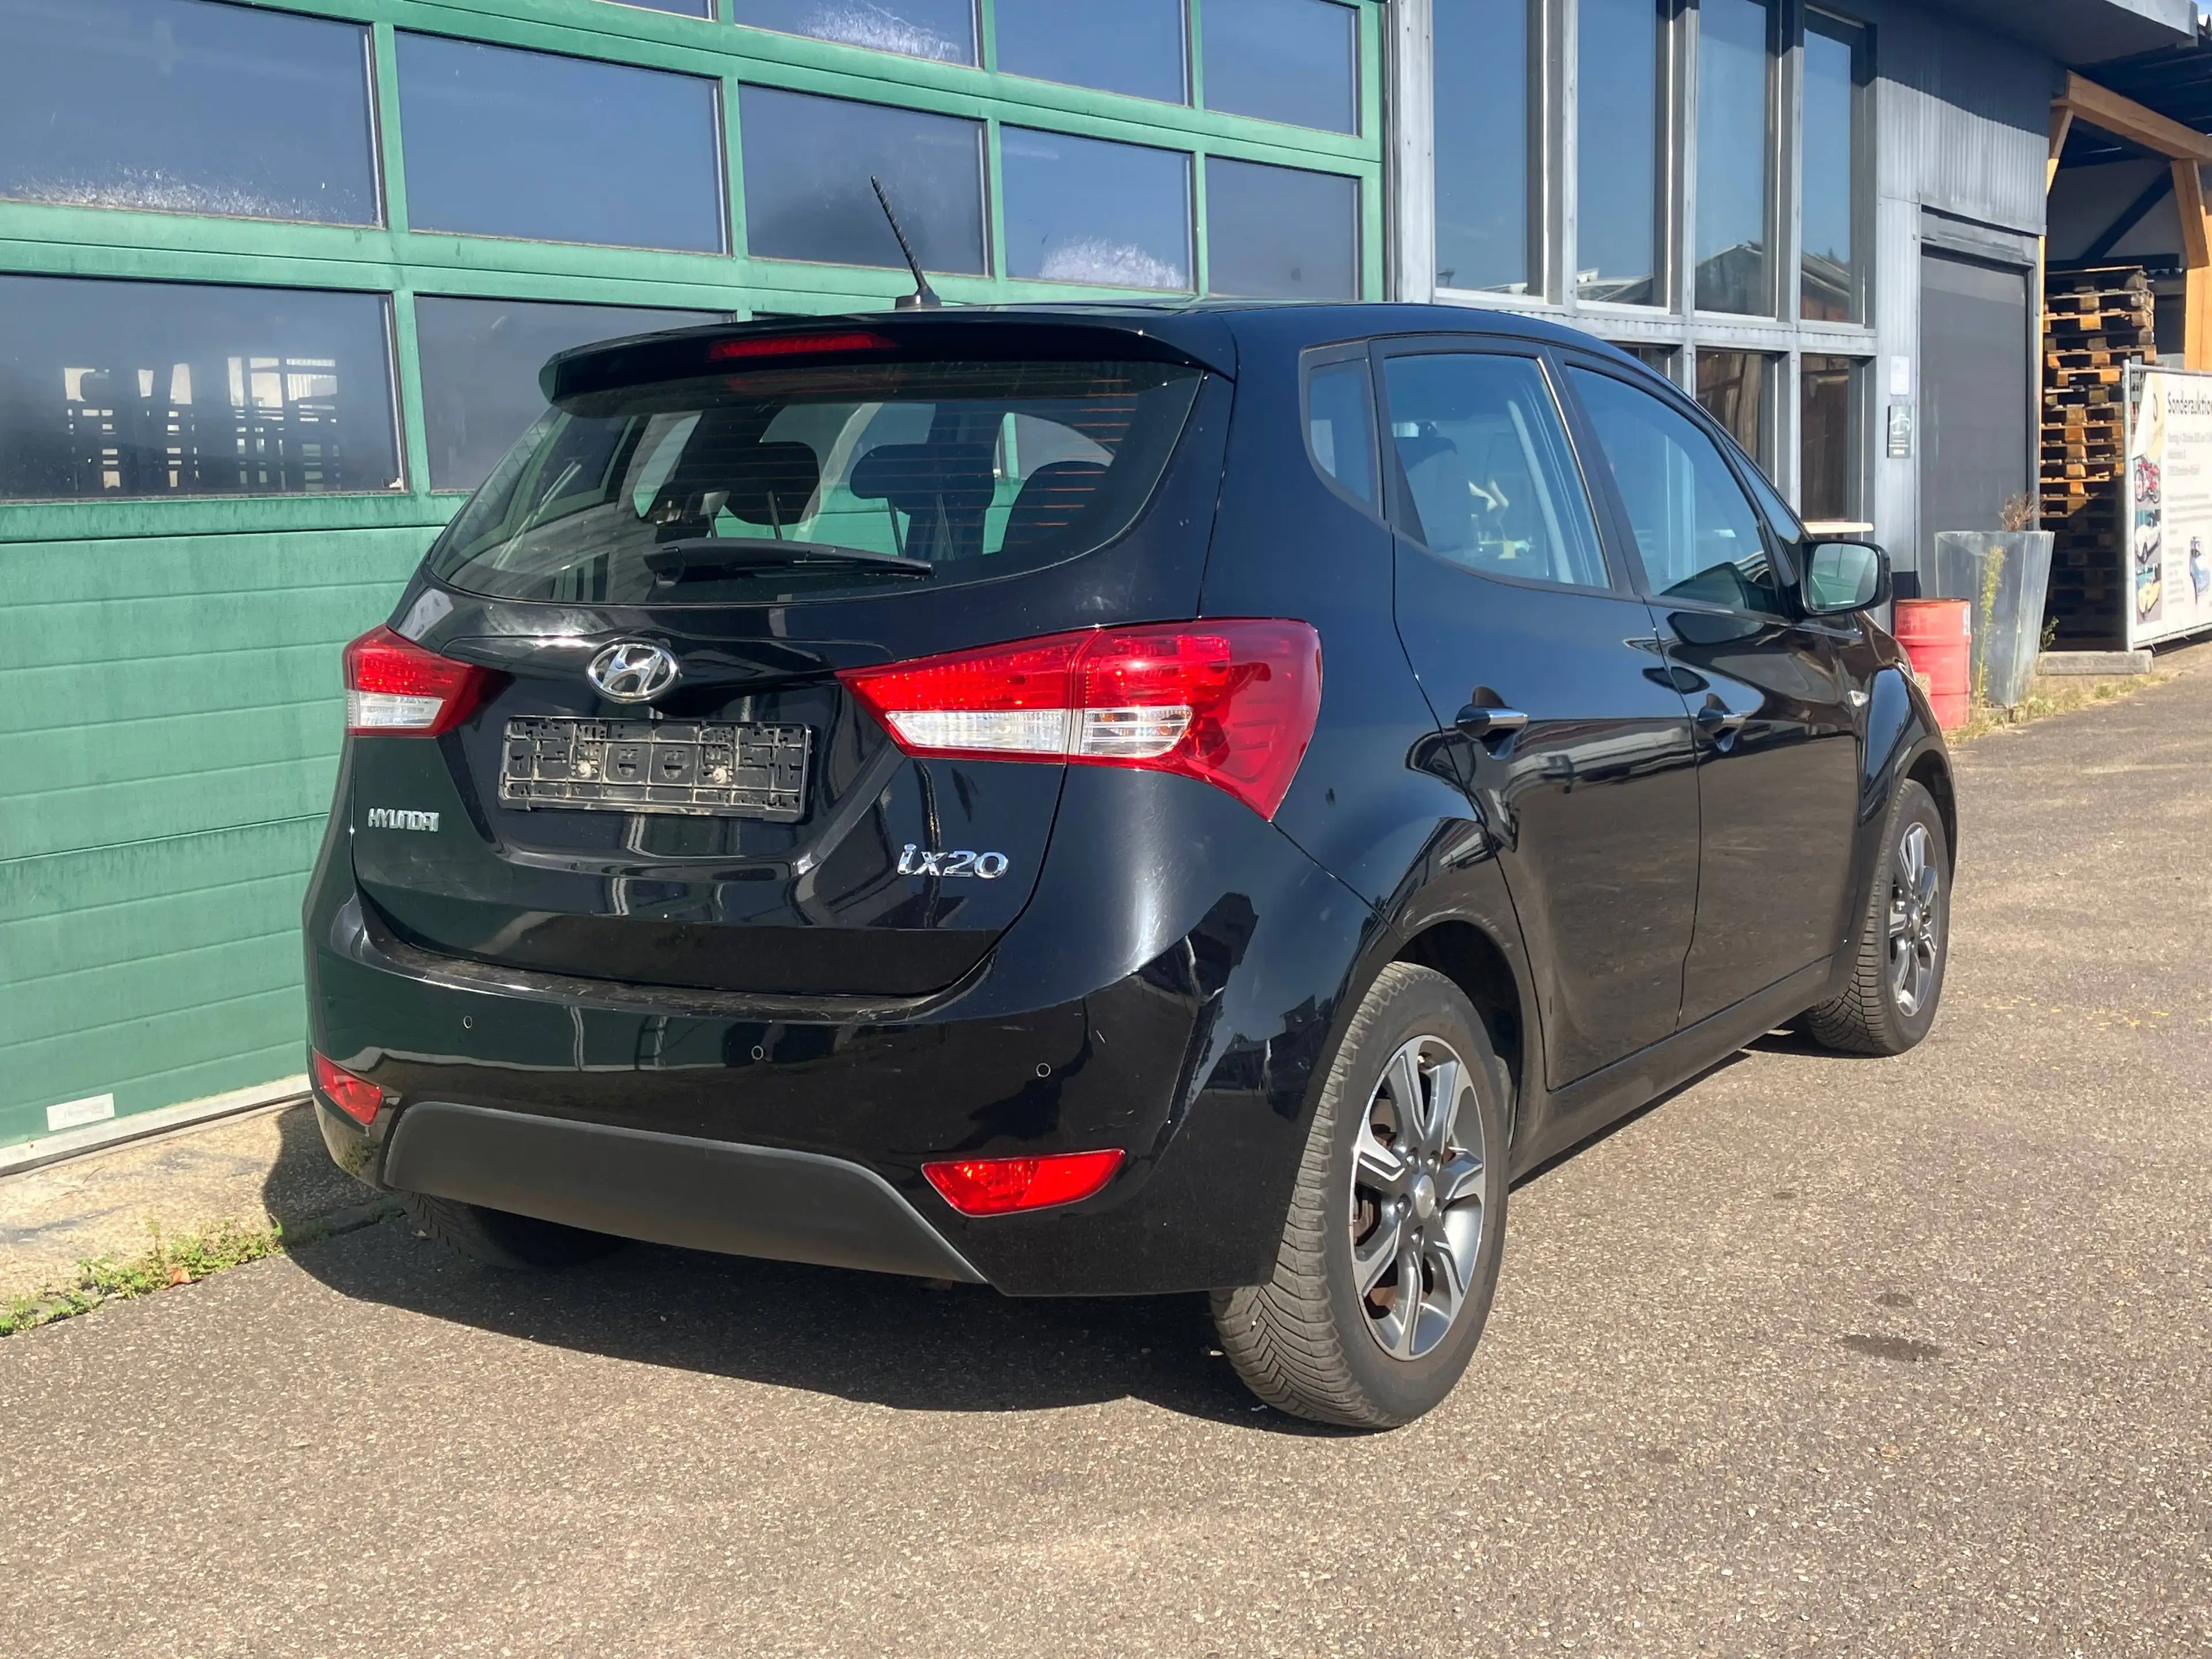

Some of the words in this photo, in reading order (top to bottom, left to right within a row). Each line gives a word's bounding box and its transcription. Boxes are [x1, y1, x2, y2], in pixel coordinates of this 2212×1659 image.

[2168, 390, 2212, 415] Sonderauktio
[368, 808, 439, 832] HYUNDAI
[897, 843, 1009, 880] ix20
